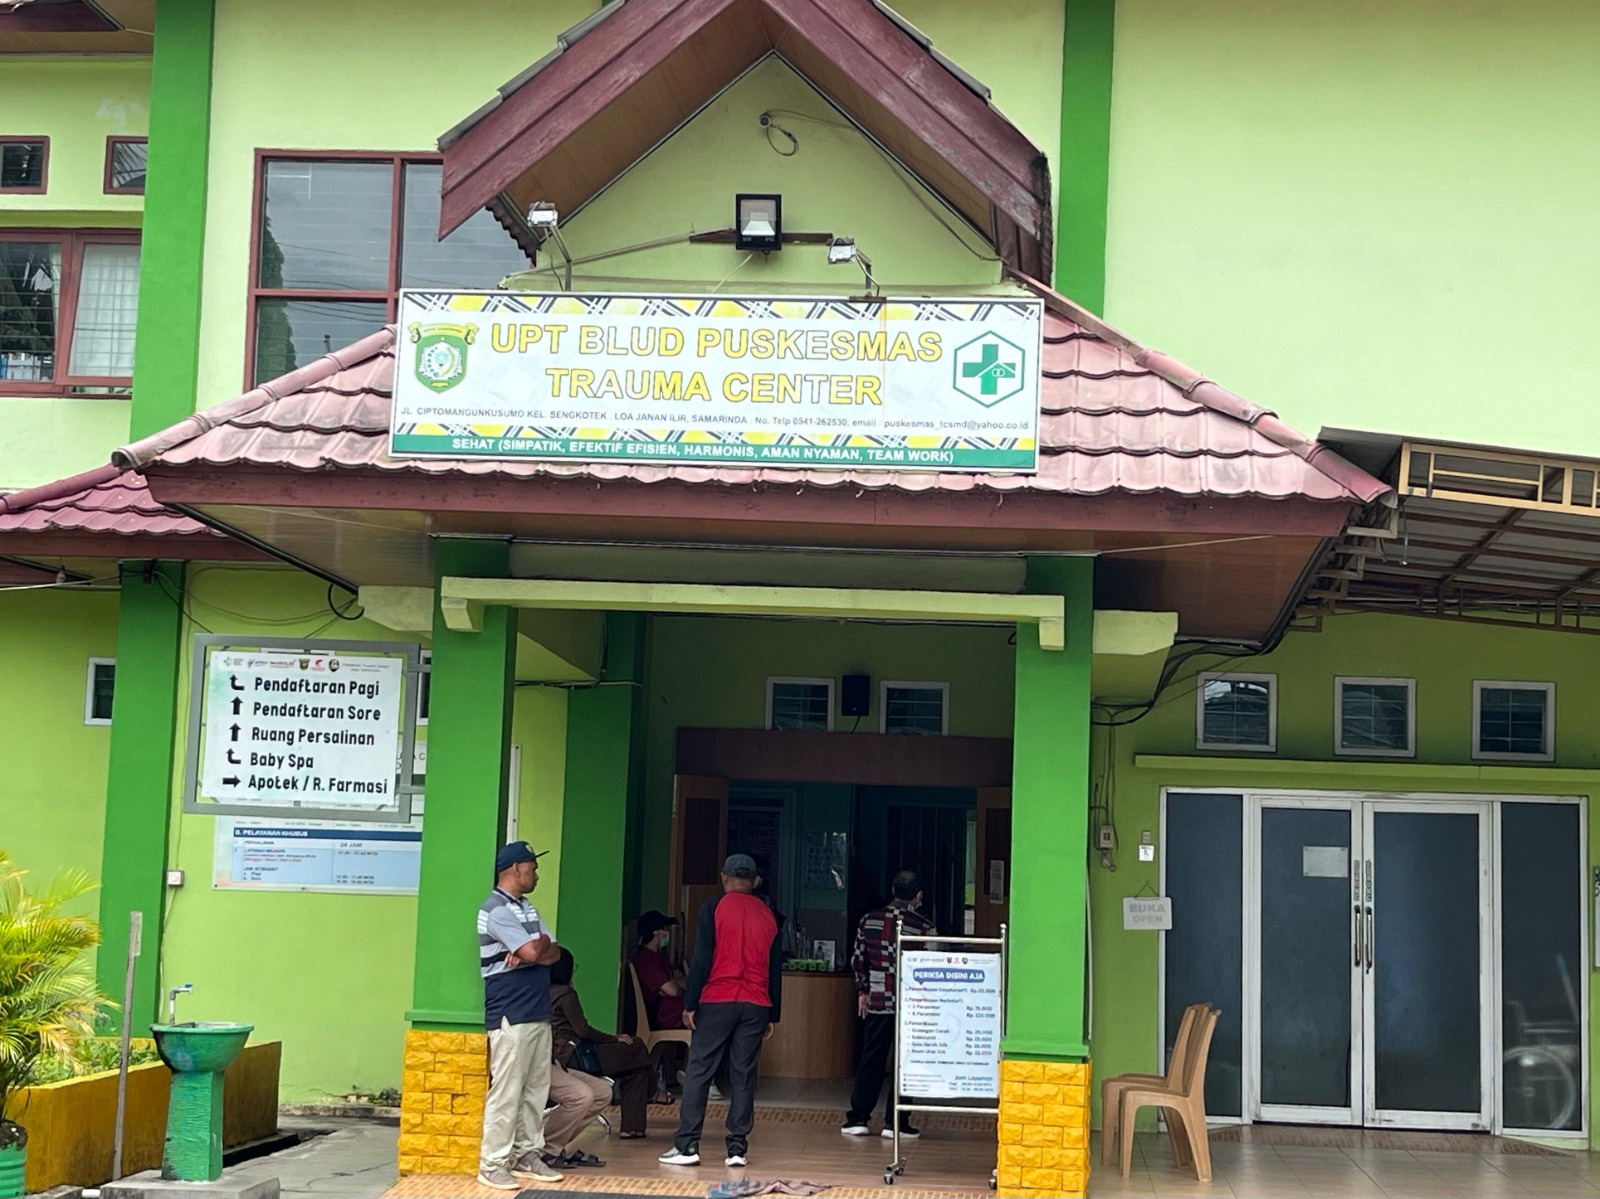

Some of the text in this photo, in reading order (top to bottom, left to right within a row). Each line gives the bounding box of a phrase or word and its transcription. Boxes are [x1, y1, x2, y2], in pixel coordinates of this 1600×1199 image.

[492, 324, 943, 362] UPT BLUD PUSKESMAS
[546, 368, 883, 405] TRAUMA CENTER
[417, 408, 525, 418] CIPTOMANGUNKUSUMO
[550, 411, 607, 420] SENGKOTEK
[615, 412, 633, 421] LOA
[636, 413, 667, 422] JANAN
[691, 414, 748, 424] SAMARINDA
[755, 417, 770, 425] No.
[773, 417, 791, 426] Telp
[452, 439, 954, 463] SEHAT (SIMPATIK, EFEKTIF EFISIEN, HARMONIS, AMAN NYAMAN, TEAM WORK)
[254, 677, 379, 699] Pendaftaran Pagi
[253, 702, 381, 721] Pendaftaran Sore
[252, 727, 375, 745] Ruang Persalinan
[250, 752, 314, 770] Baby Spa
[248, 775, 298, 792] Apotek
[313, 778, 325, 791] R.
[329, 778, 387, 794] Farmasi
[1129, 904, 1165, 912] BUKA
